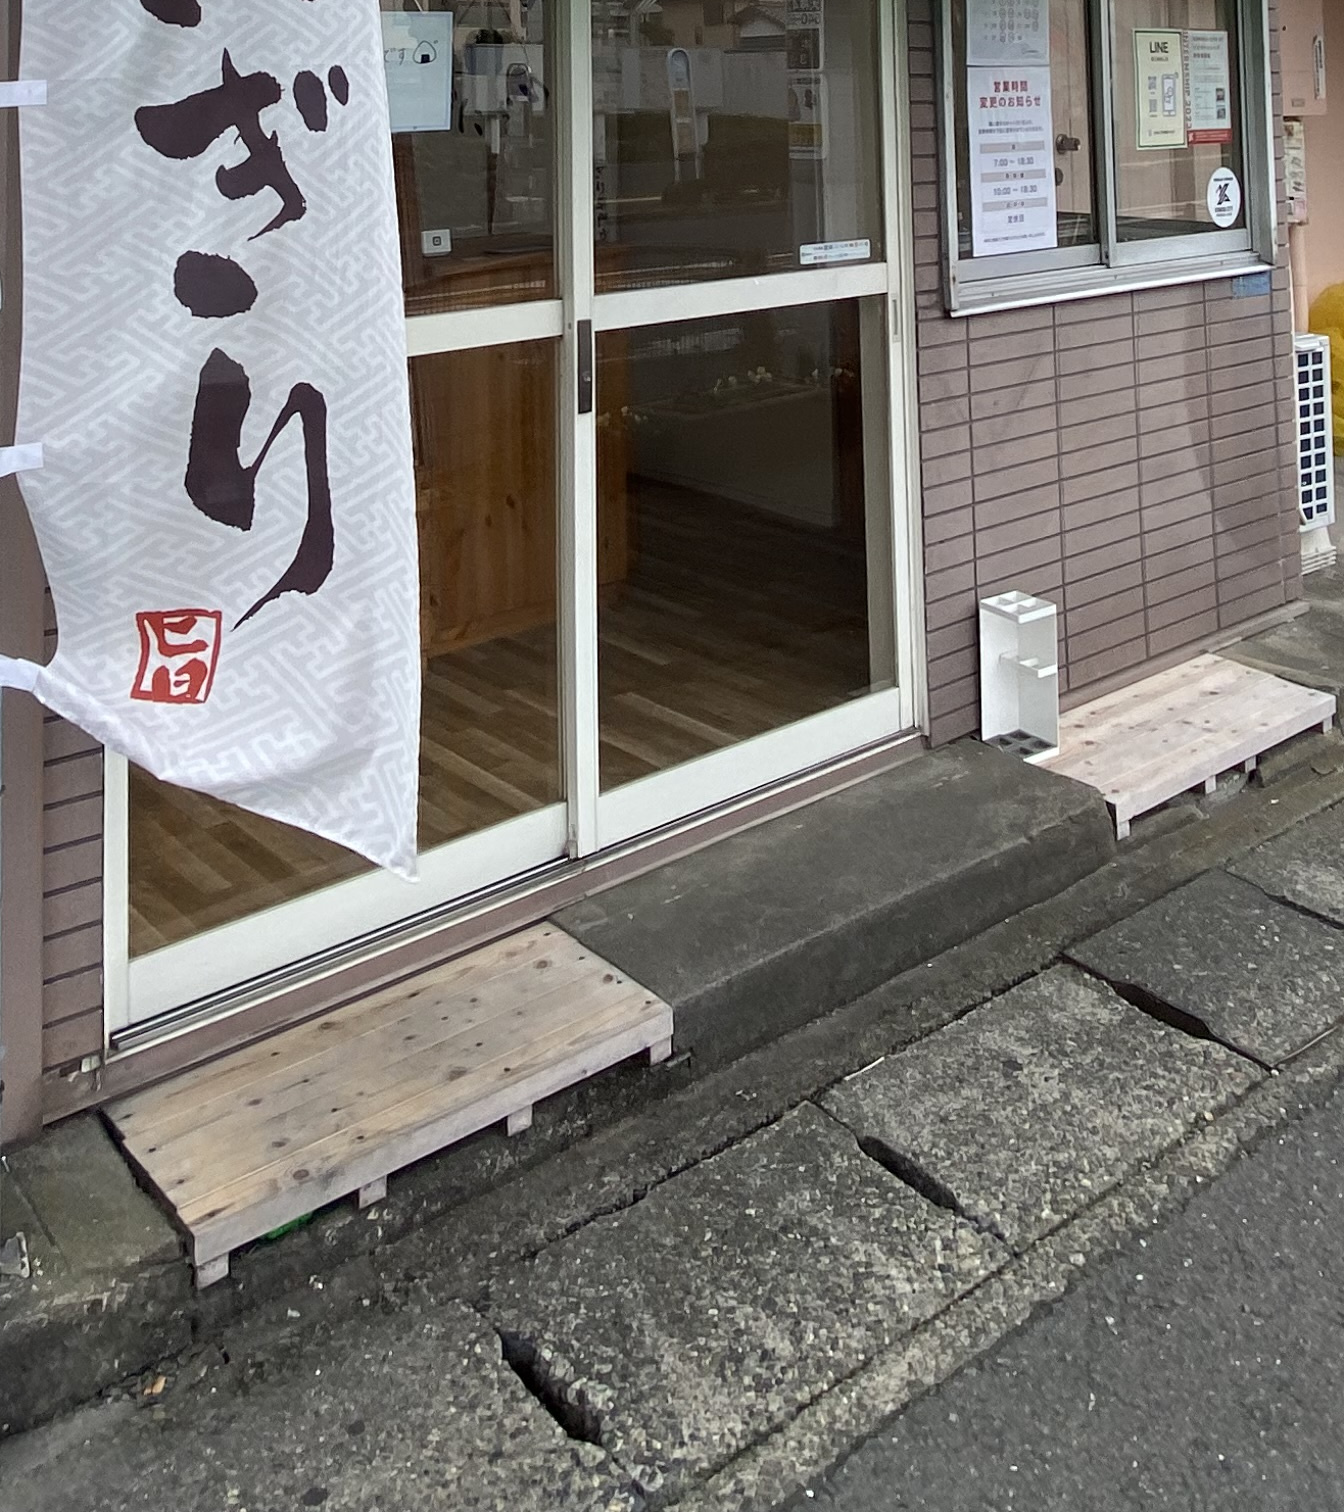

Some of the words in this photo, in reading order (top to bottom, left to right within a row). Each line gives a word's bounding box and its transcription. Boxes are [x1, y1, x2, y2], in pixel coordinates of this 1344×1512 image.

[1149, 41, 1169, 54] LINE
[993, 80, 1029, 93] 営業時間
[978, 95, 1042, 109] 変更のお知らせ
